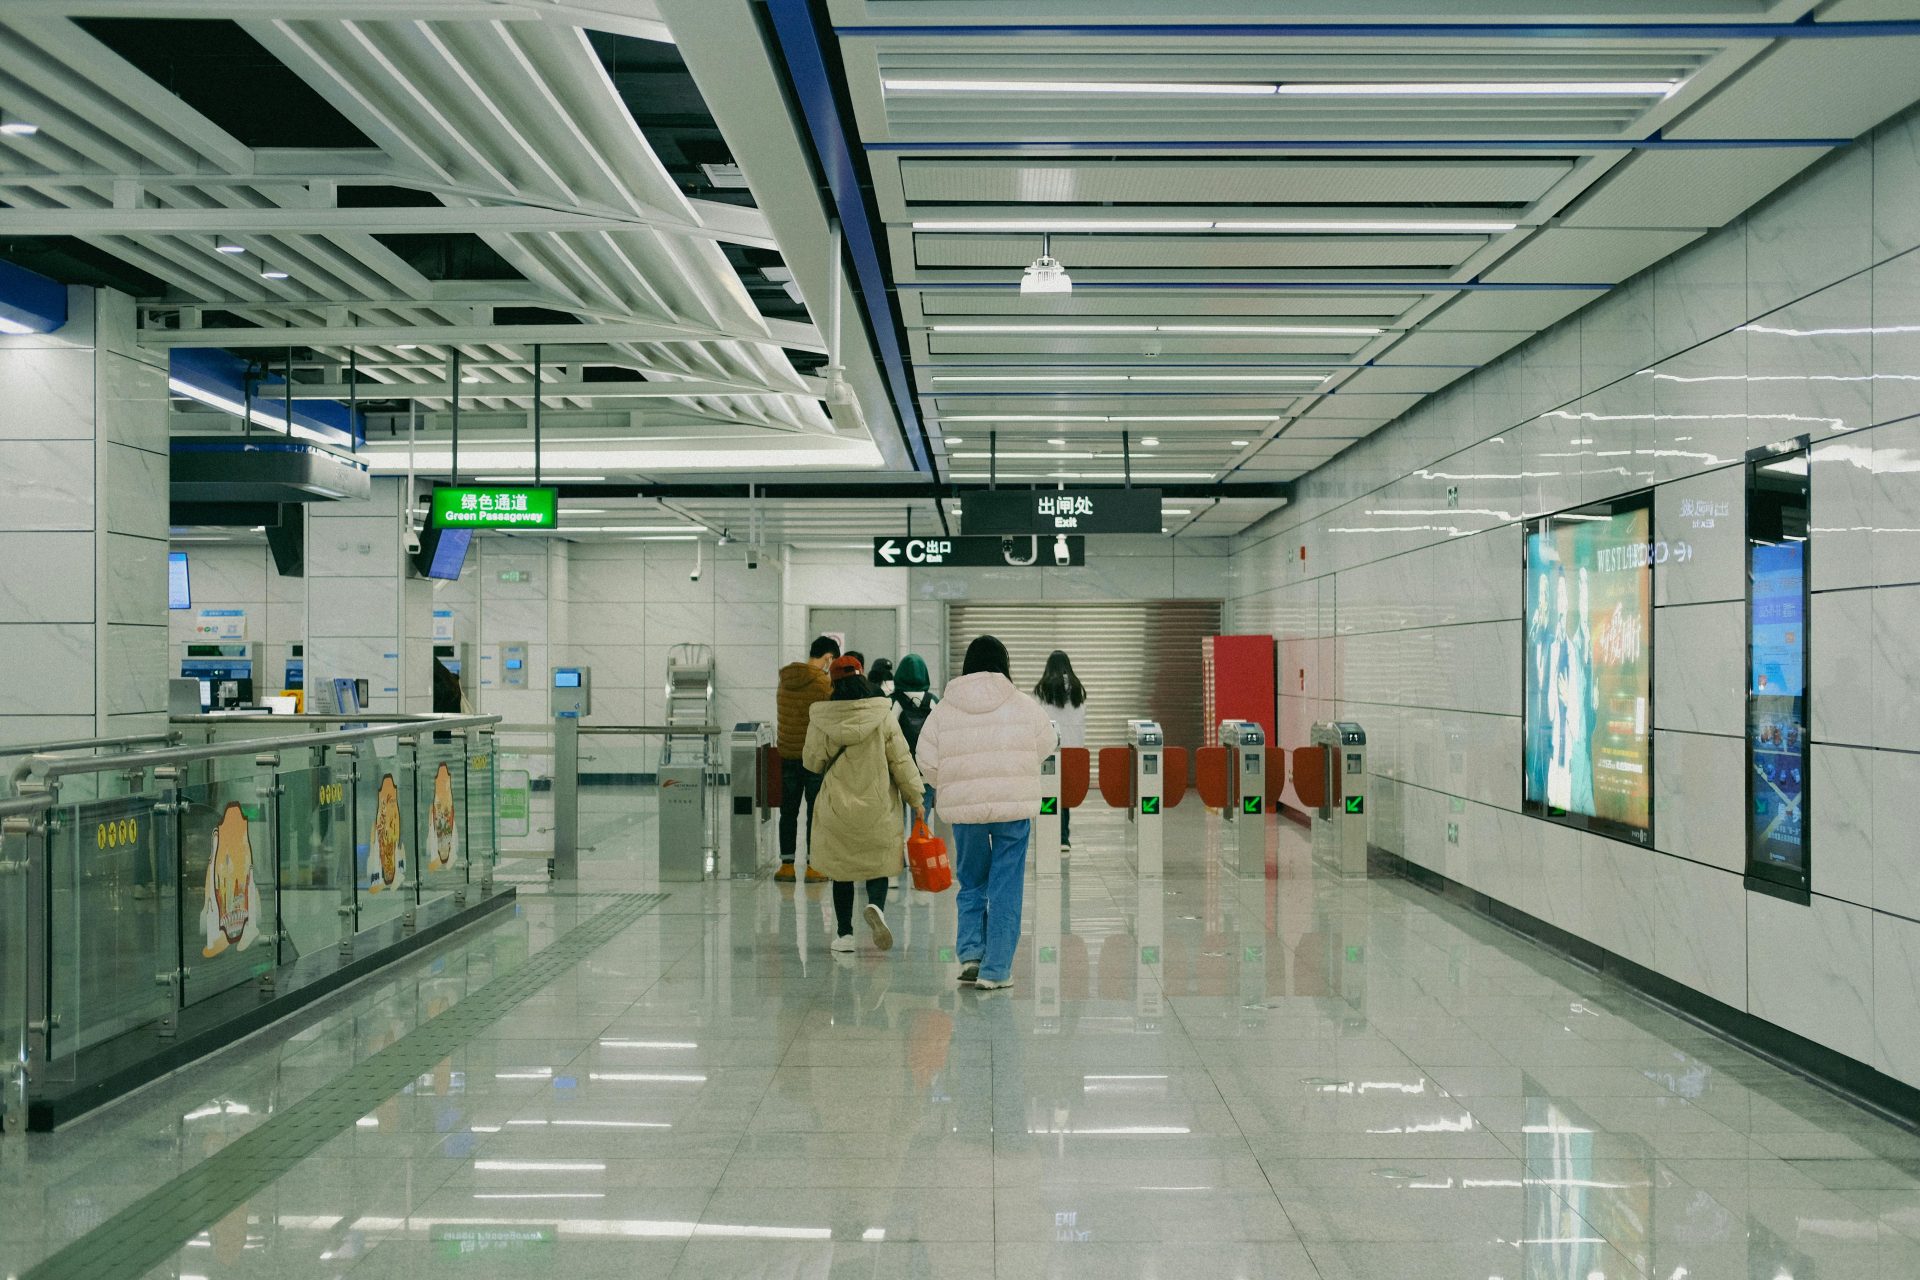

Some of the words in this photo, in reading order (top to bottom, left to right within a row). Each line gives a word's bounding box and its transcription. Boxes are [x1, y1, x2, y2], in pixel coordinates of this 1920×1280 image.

[461, 494, 528, 511] 绿色通道
[1038, 496, 1093, 515] 出闸处
[445, 510, 477, 521] Green
[479, 510, 543, 523] Passageway
[1055, 516, 1077, 528] Exit
[906, 539, 926, 563] C
[926, 540, 951, 554] 出口
